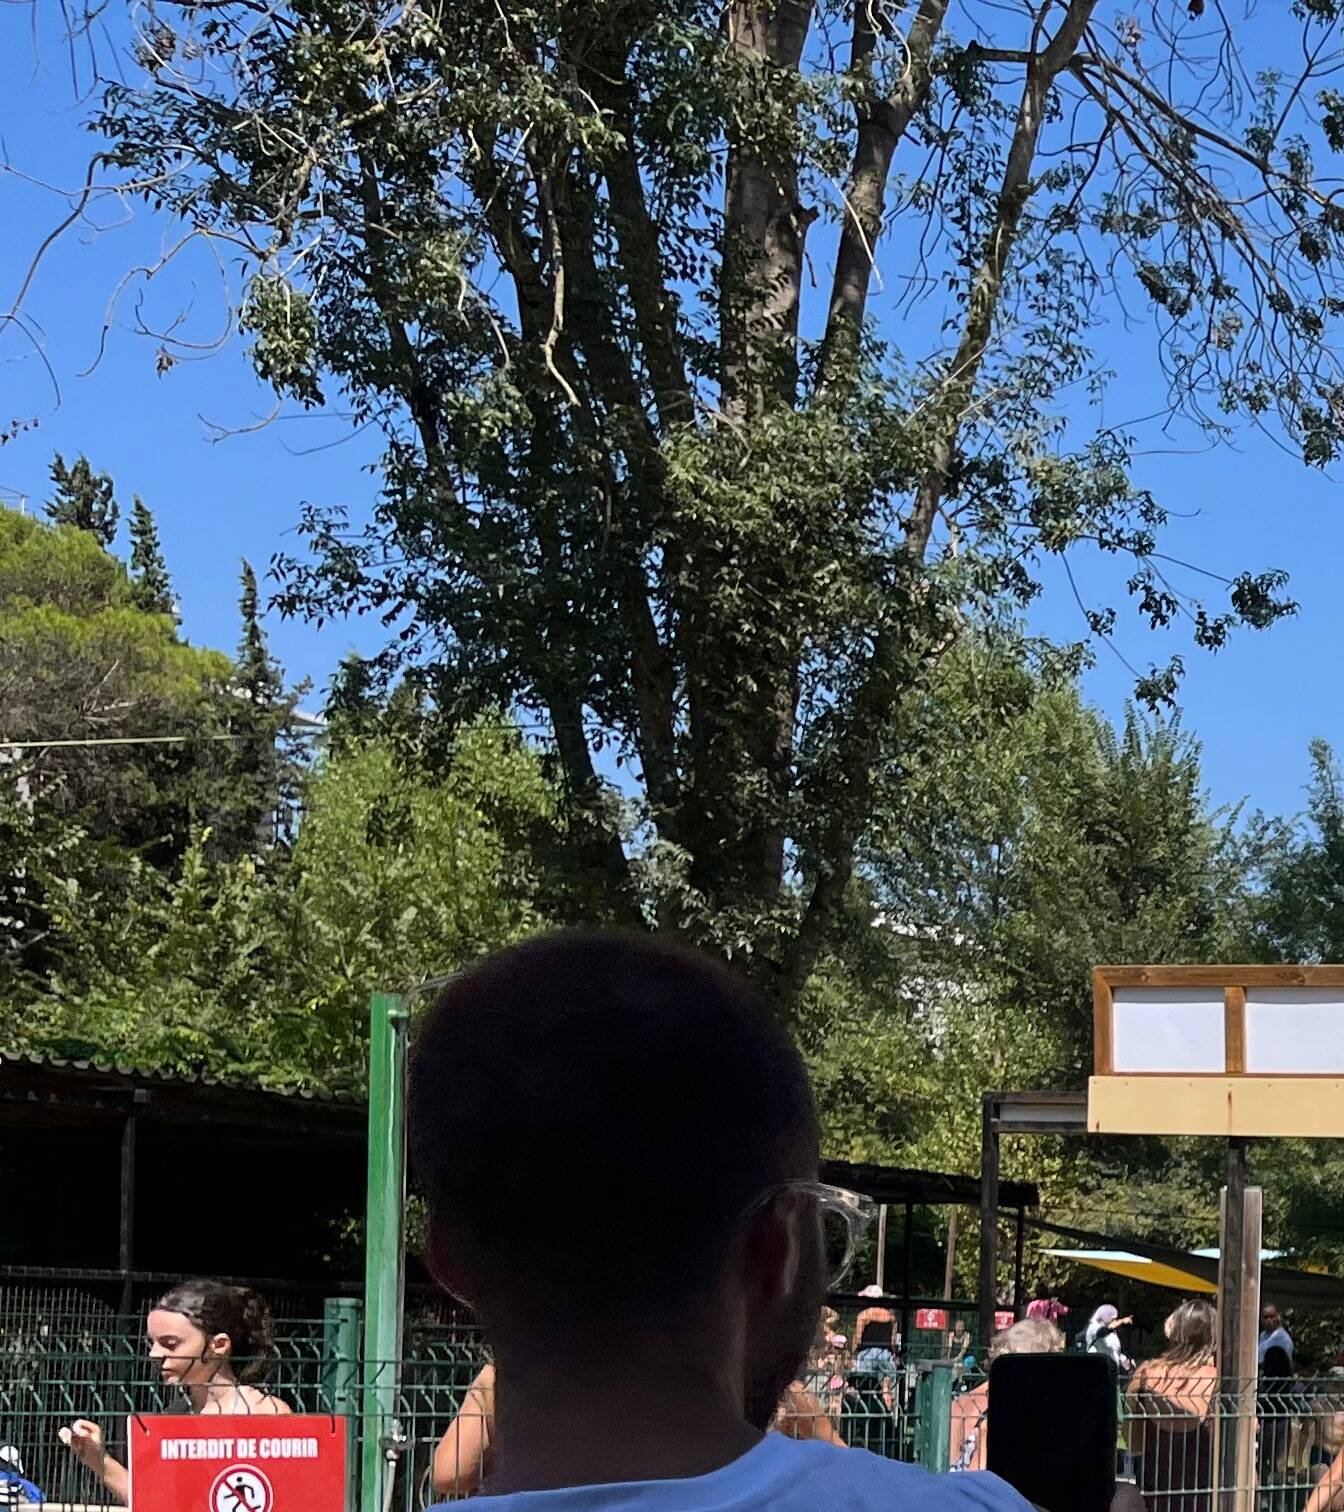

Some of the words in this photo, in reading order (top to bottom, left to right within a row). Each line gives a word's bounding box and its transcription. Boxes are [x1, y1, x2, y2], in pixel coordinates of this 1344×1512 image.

[161, 1438, 235, 1460] INTERDIT
[236, 1438, 257, 1459] DE
[259, 1437, 319, 1459] COURIR
